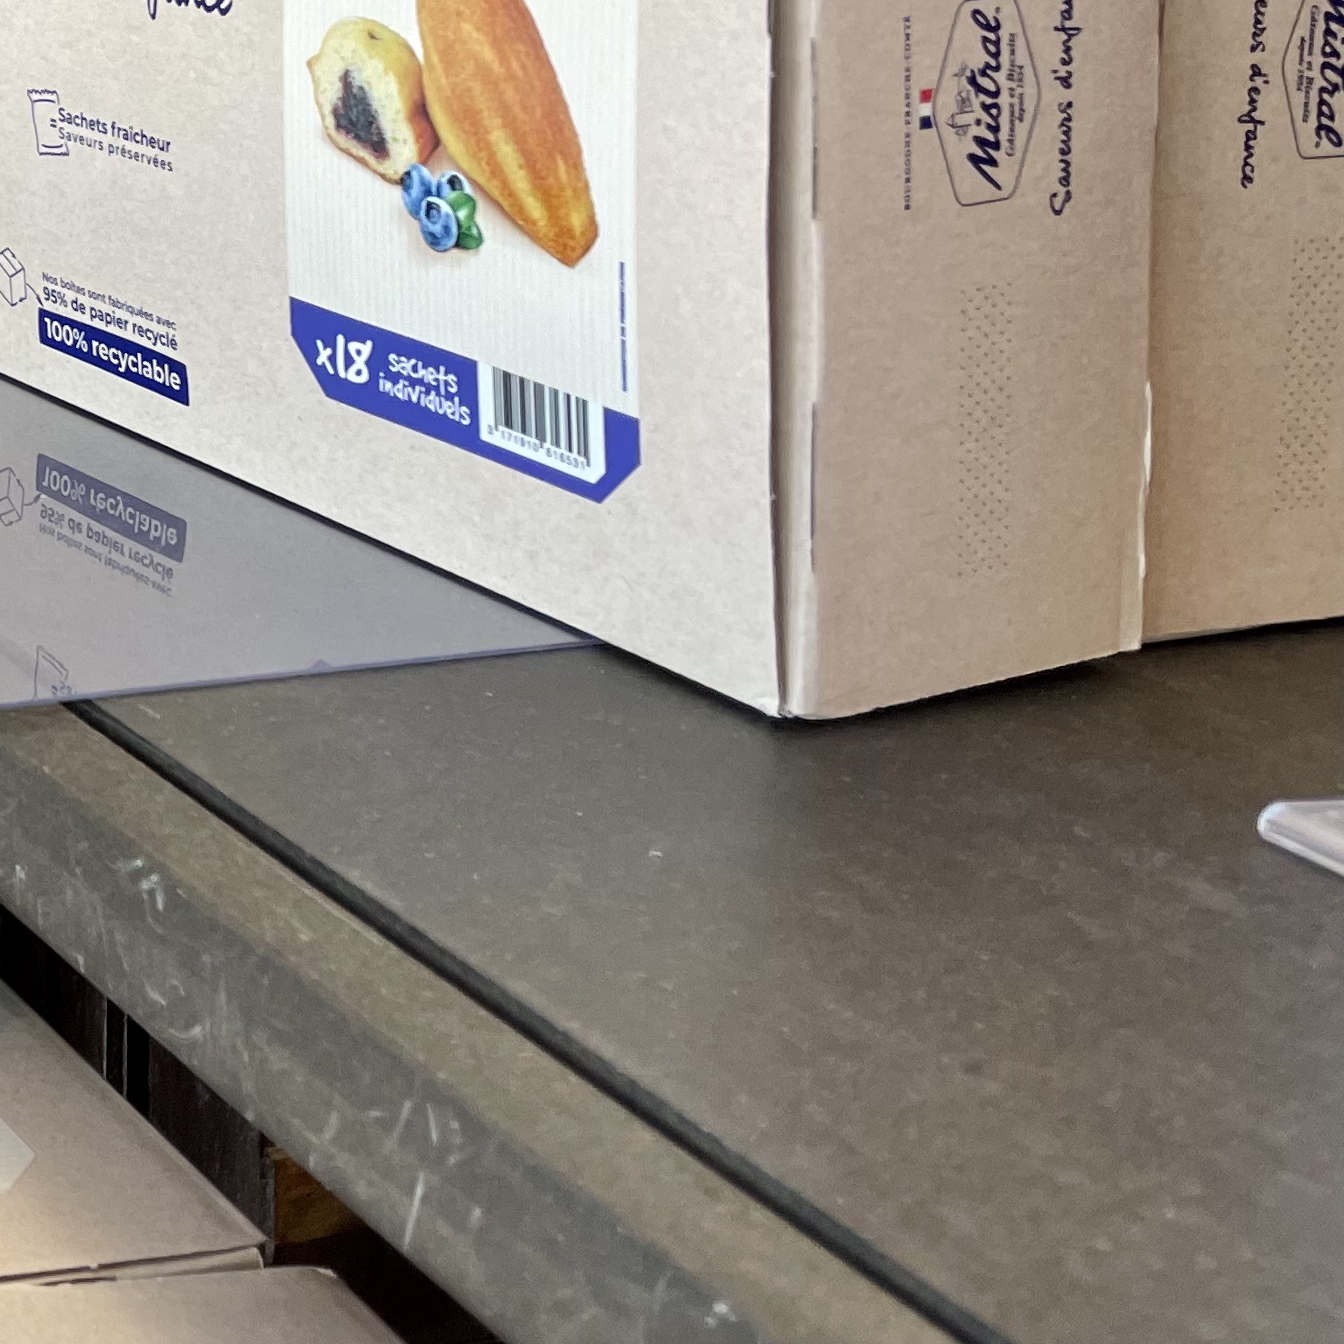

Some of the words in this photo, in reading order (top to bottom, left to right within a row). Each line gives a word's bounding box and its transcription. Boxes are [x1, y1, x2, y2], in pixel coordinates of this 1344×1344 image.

[966, 7, 1002, 191] Mistral
[1237, 63, 1268, 189] d'enfance
[58, 107, 108, 135] Sachets
[111, 120, 171, 153] fraîcheur
[58, 127, 104, 152] Saveurs
[107, 140, 173, 172] préservées
[1049, 99, 1074, 216] Saveurs
[42, 272, 58, 286] Nos
[60, 277, 86, 296] boîtes
[88, 290, 106, 304] sont
[108, 295, 154, 320] fabriquées
[156, 315, 177, 331] avec
[43, 286, 68, 308] 95%
[71, 297, 86, 314] de
[90, 306, 128, 331] papier
[132, 322, 178, 350] recyclé
[44, 317, 88, 352] 100%
[92, 340, 181, 391] recyclable
[315, 333, 374, 384] x18
[388, 353, 458, 393] sachets
[378, 372, 471, 426] individuels
